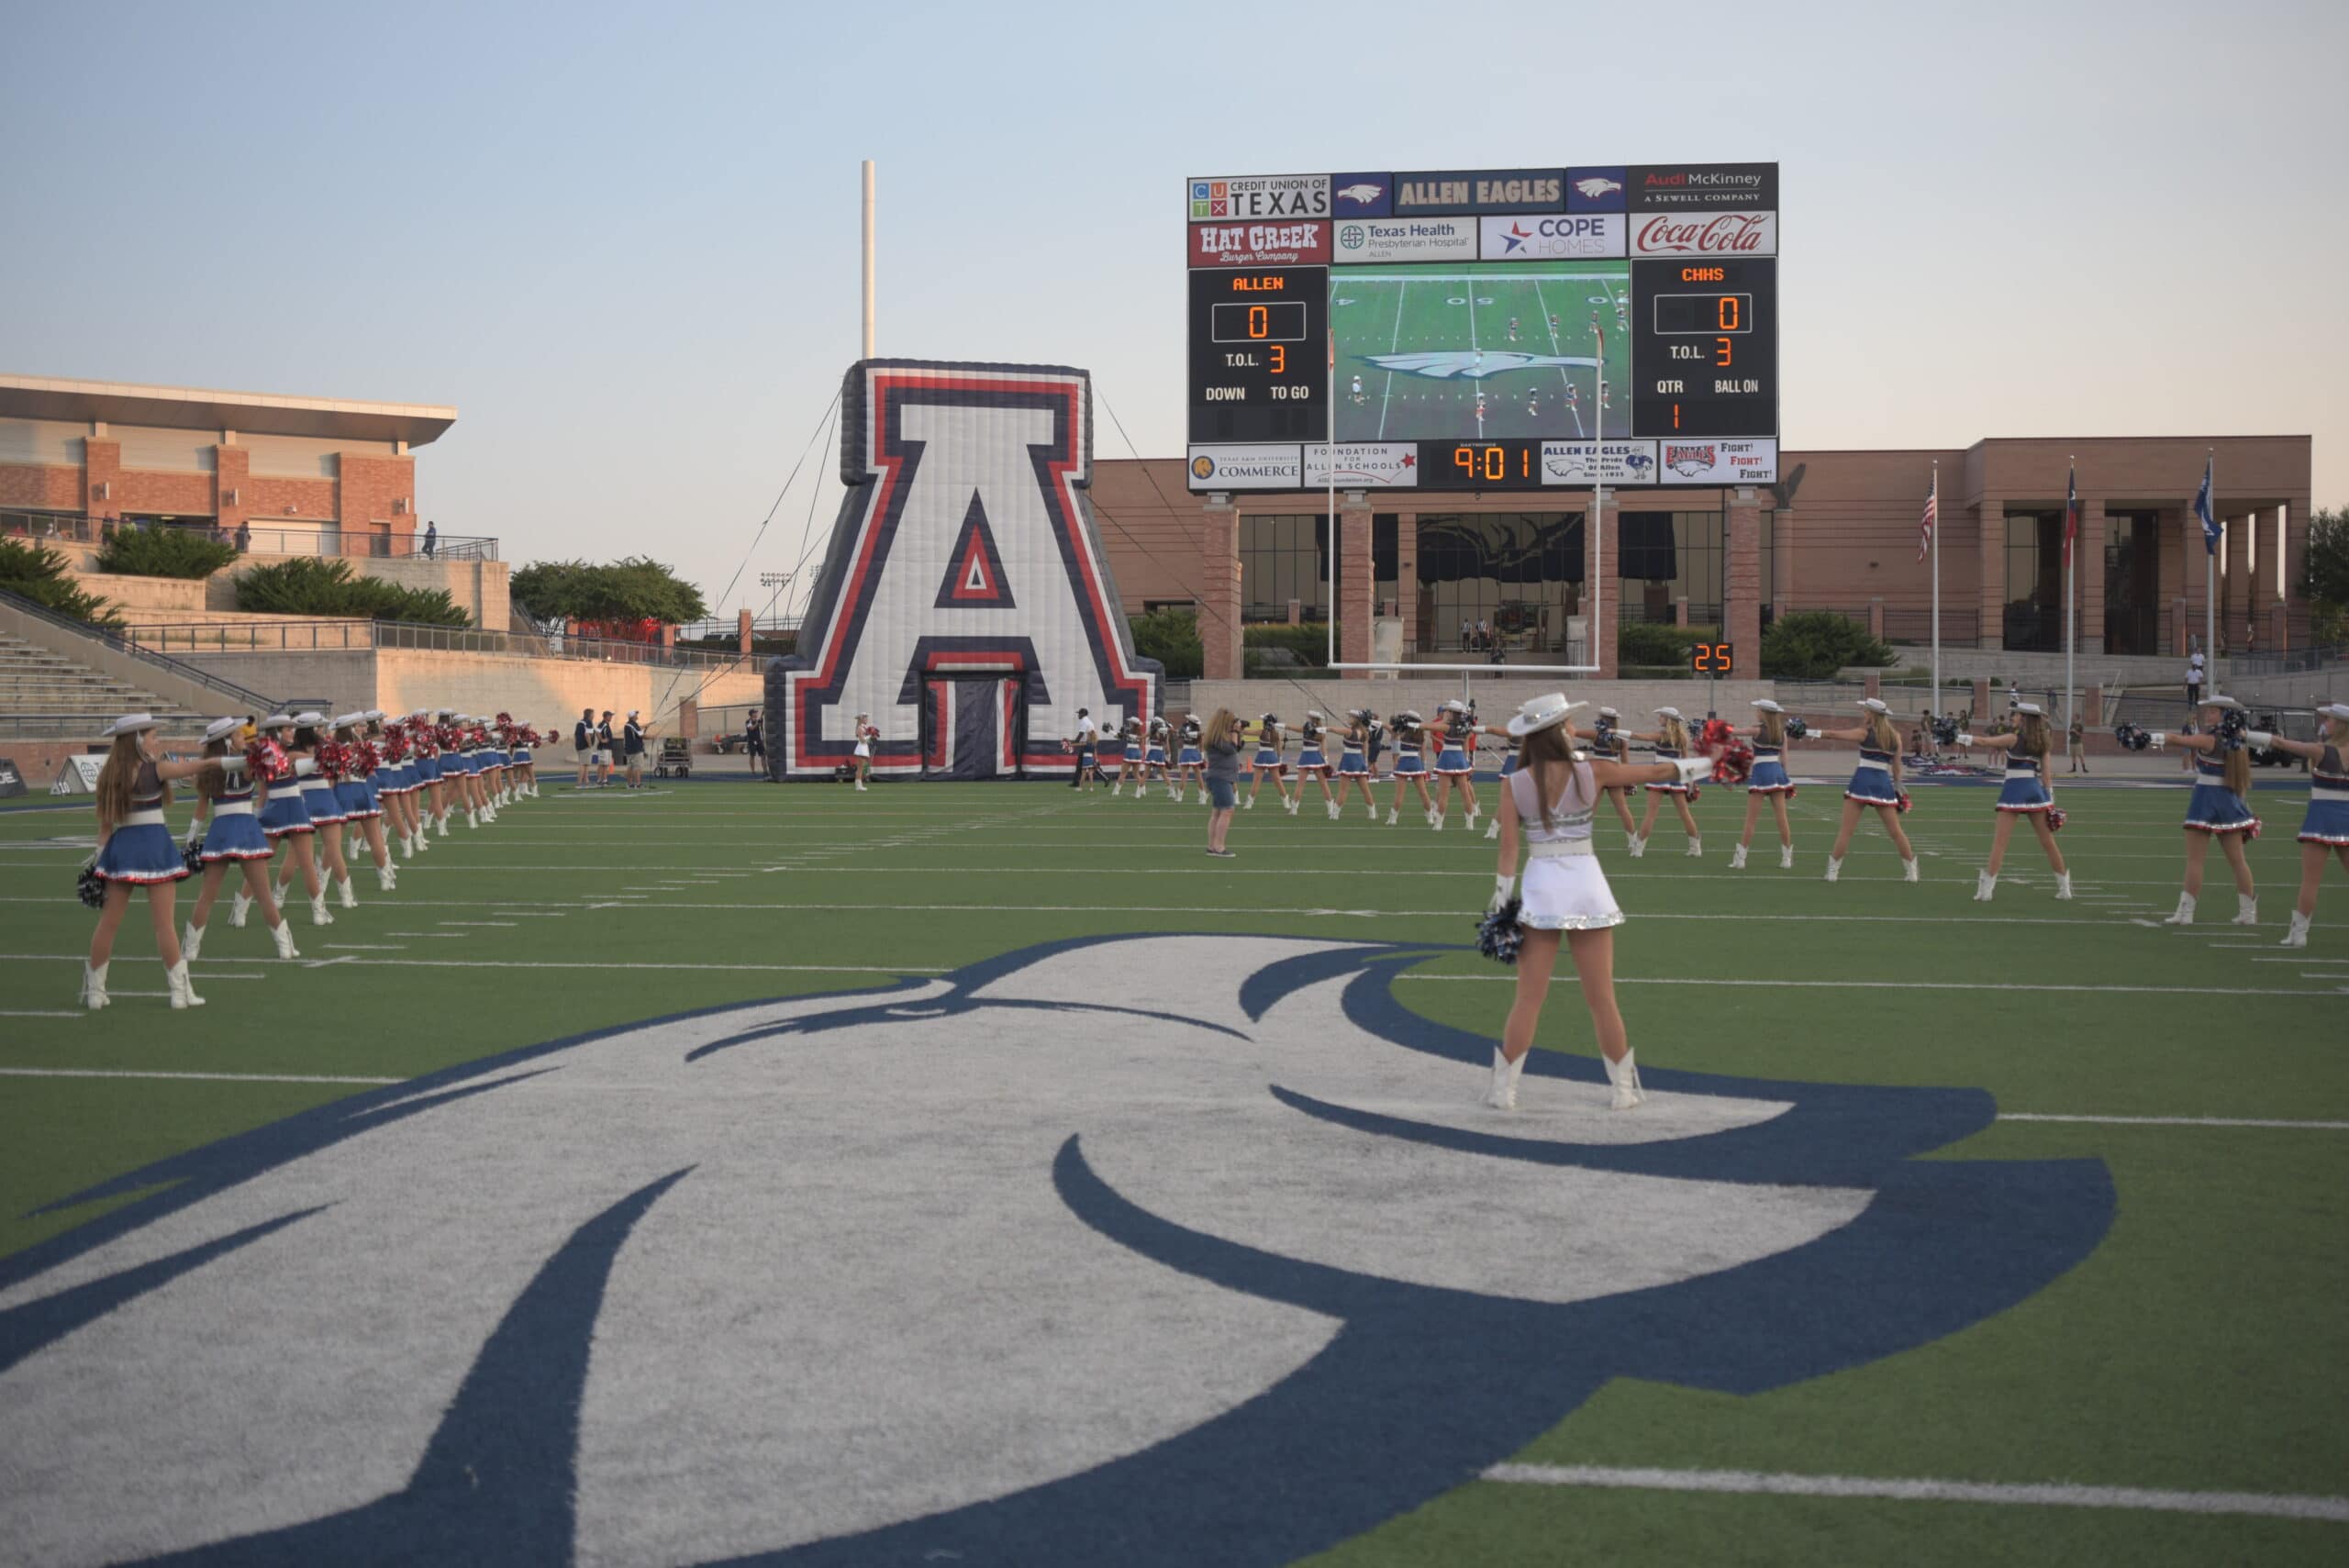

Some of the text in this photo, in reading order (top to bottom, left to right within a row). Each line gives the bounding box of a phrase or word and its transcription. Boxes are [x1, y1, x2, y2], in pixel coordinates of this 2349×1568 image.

[1230, 179, 1328, 191] CREDIT UNION OF
[1644, 172, 1762, 186] Audi McKinney
[1398, 178, 1560, 206] ALLEN EAGLES
[1655, 193, 1700, 203] SEWELL
[1705, 193, 1760, 202] COMPANY
[1230, 190, 1327, 216] TEXAS
[1368, 223, 1455, 239] Texas Health
[1539, 218, 1605, 238] COPE
[1637, 214, 1769, 253] Coca-Cola
[1200, 223, 1319, 254] HAT CREEK
[1368, 237, 1468, 251] Presbyterian Hospital
[1539, 238, 1605, 255] HOMES
[1219, 250, 1299, 264] Burger Company
[1681, 268, 1725, 282] CHHS
[1232, 277, 1284, 291] ALLEN
[1719, 296, 1739, 329] 0
[1249, 306, 1268, 339] 0
[1670, 337, 1731, 366] T.O.L. 3
[1226, 345, 1285, 373] T.O.L. 3
[1270, 385, 1309, 400] TO GO
[1656, 380, 1684, 394] QTR
[1714, 379, 1759, 393] BALL ON
[1206, 386, 1246, 401] DOWN
[1674, 404, 1680, 429] 1
[1314, 447, 1388, 456] FONDATION
[1544, 446, 1582, 455] ALLEN
[1720, 442, 1753, 452] FIGHT!
[1348, 462, 1402, 471] SCHOOLS
[1730, 455, 1763, 465] FIGHT!
[1219, 465, 1299, 478] COMMERCE
[1740, 468, 1773, 478] FIGHT!
[1695, 645, 1731, 671] 25
